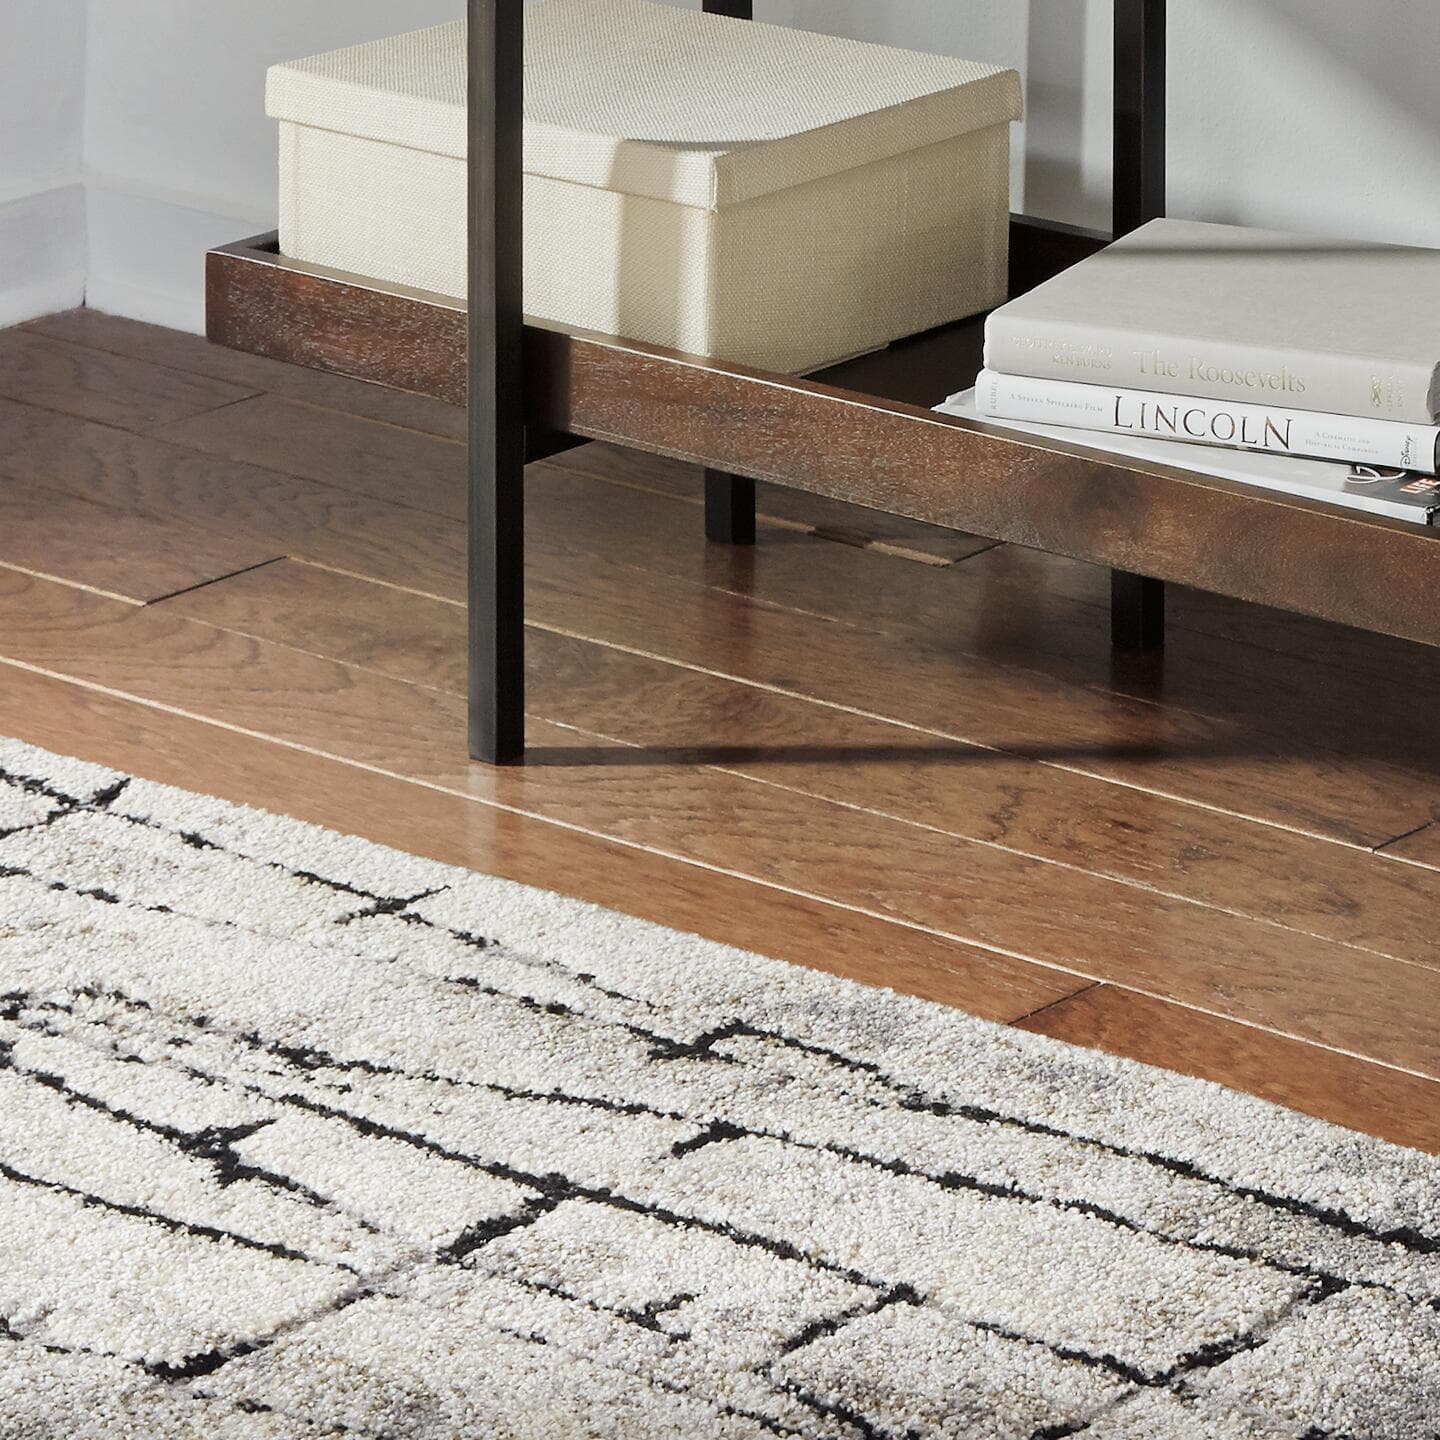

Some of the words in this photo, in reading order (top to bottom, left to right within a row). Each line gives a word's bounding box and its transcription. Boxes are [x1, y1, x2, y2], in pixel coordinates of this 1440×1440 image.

[1133, 350, 1178, 378] The
[1188, 357, 1307, 393] Roosevelts
[1113, 395, 1293, 450] LINCOLN
[1400, 434, 1413, 469] Disney
